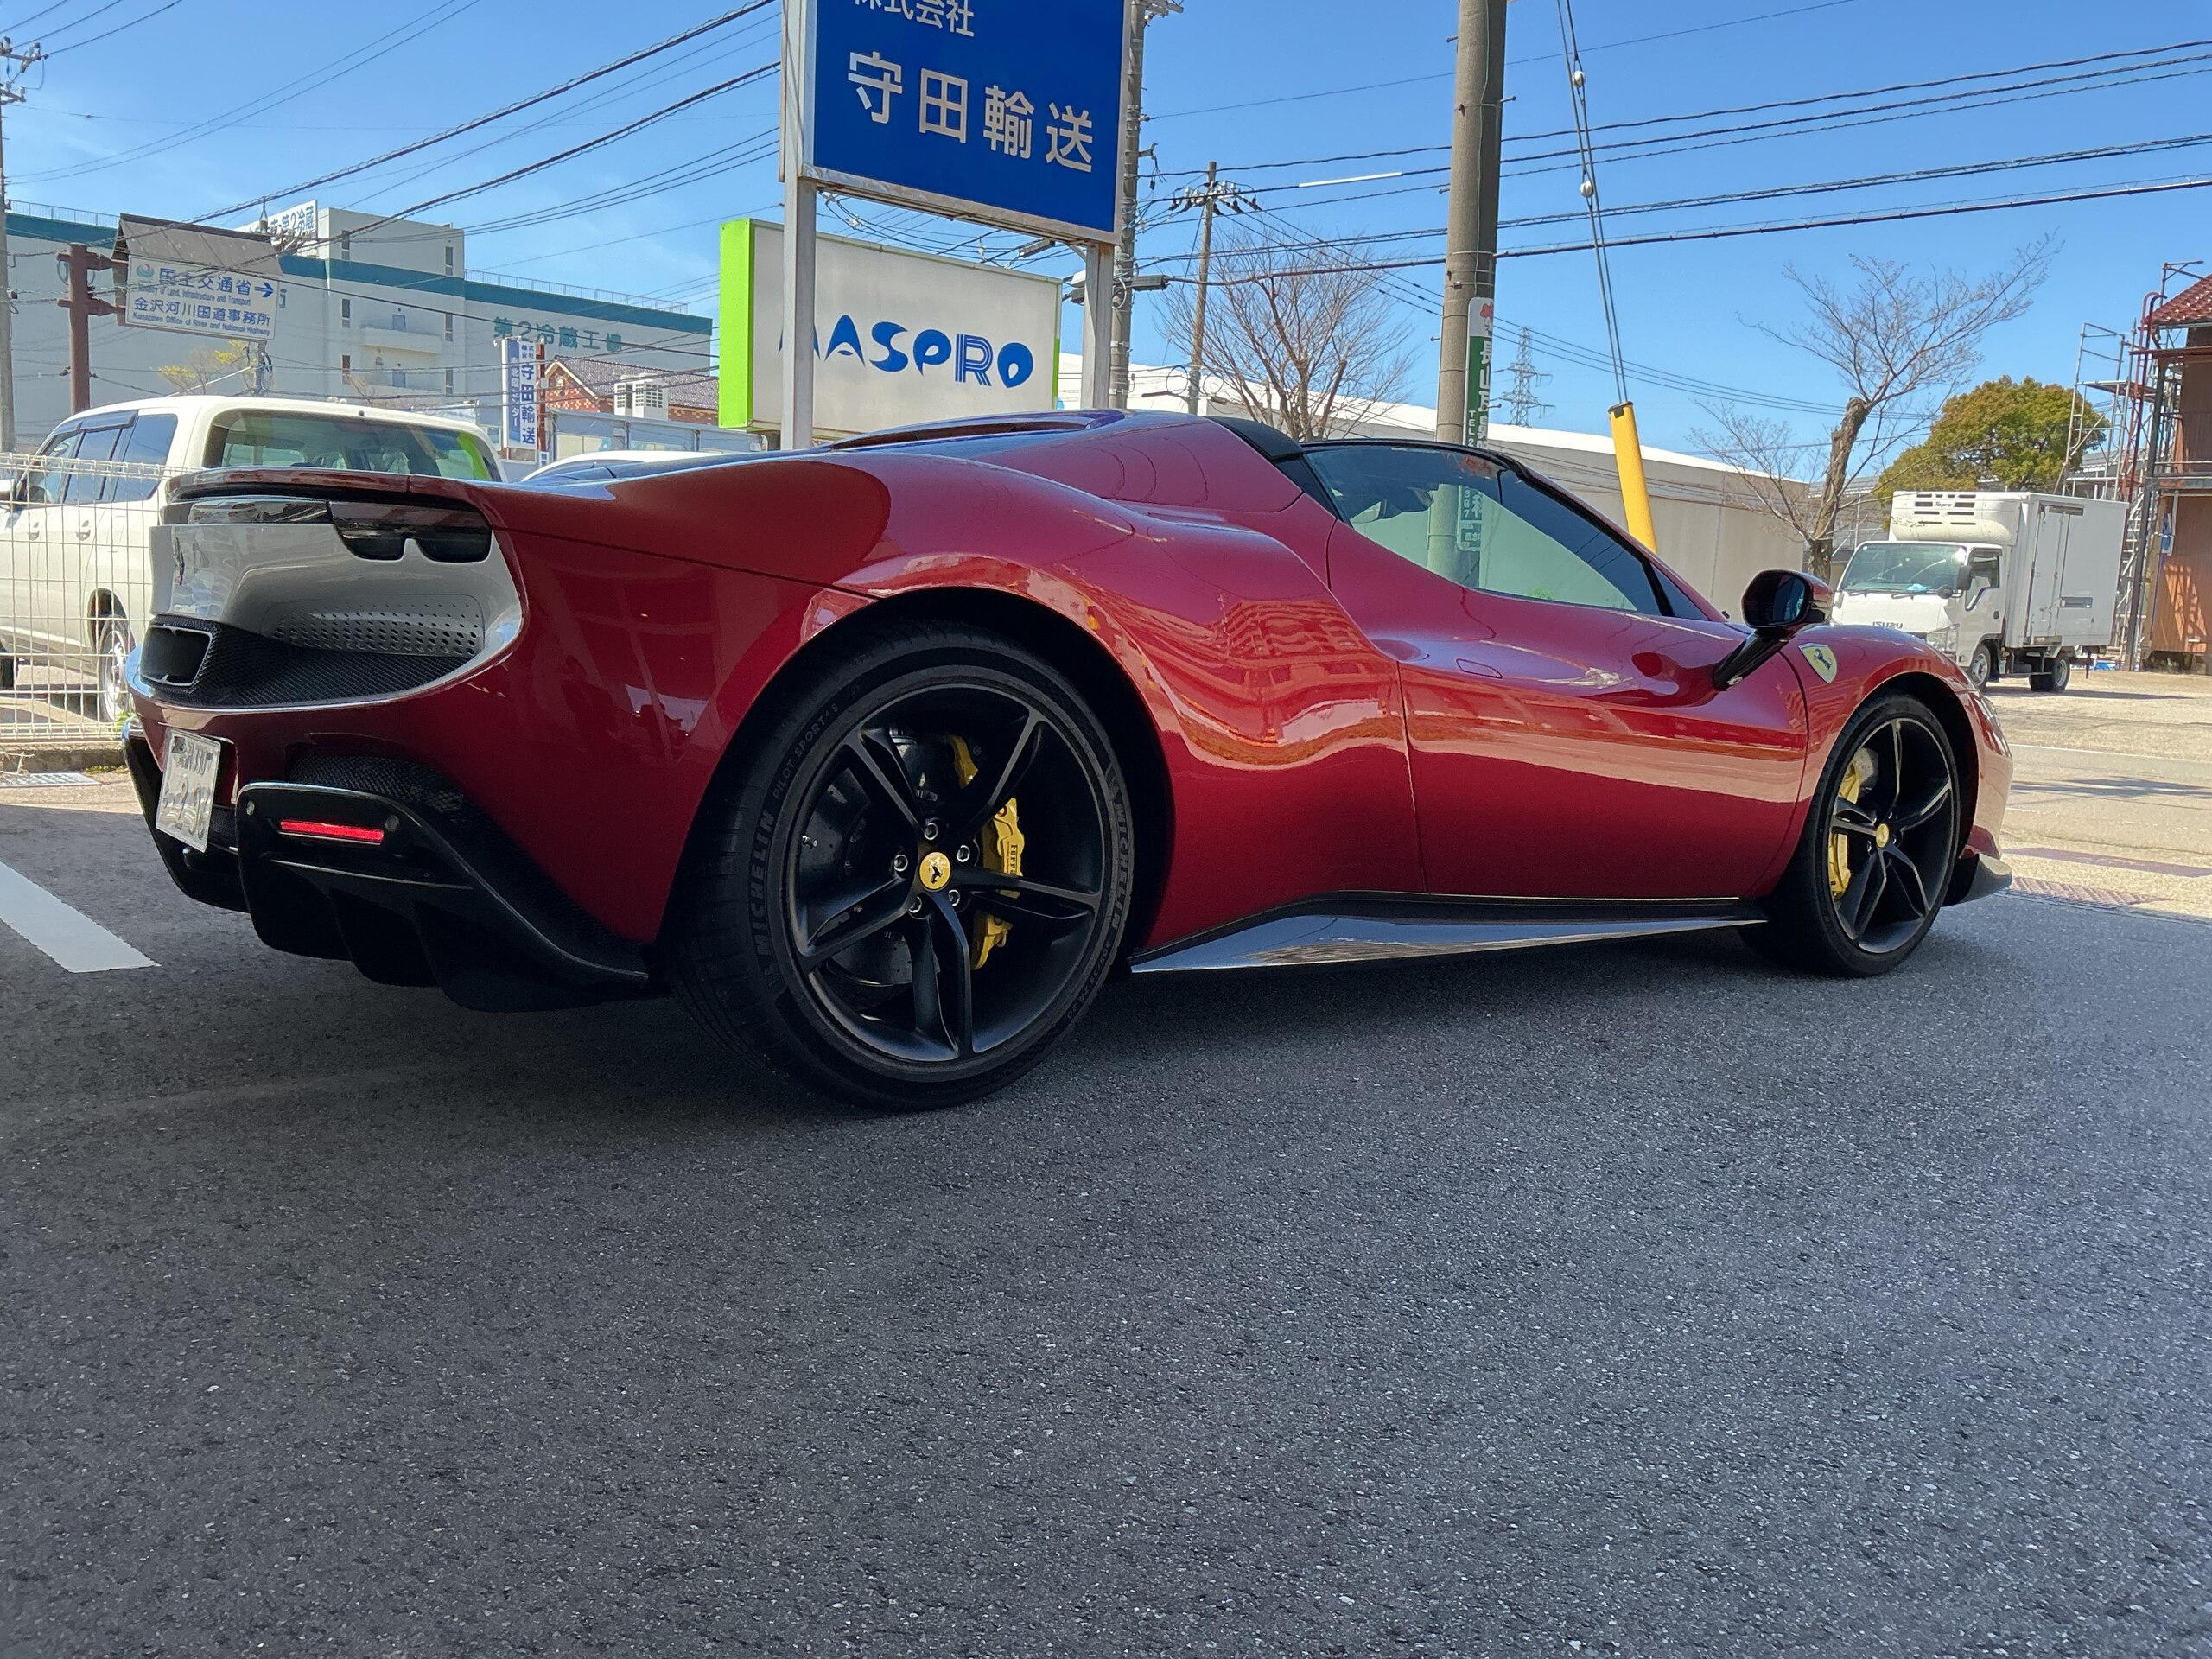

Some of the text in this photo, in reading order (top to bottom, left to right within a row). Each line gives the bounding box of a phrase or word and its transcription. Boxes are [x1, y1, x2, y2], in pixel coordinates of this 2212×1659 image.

[847, 51, 1094, 173] 守田輸送
[159, 267, 252, 296] 国土交通省
[133, 296, 272, 327] 金沢河川国道事務所
[166, 315, 184, 326] Office
[193, 319, 208, 328] River
[209, 321, 221, 331] and
[222, 323, 246, 334] National
[779, 315, 1034, 389] ASPRO
[1468, 410, 1477, 435] TEL
[1872, 620, 1904, 629] ISUZU
[772, 758, 795, 800] PILOT
[794, 715, 826, 758] SPORT
[750, 809, 776, 957] MICHELIN
[1110, 803, 1130, 931] MICHELIN
